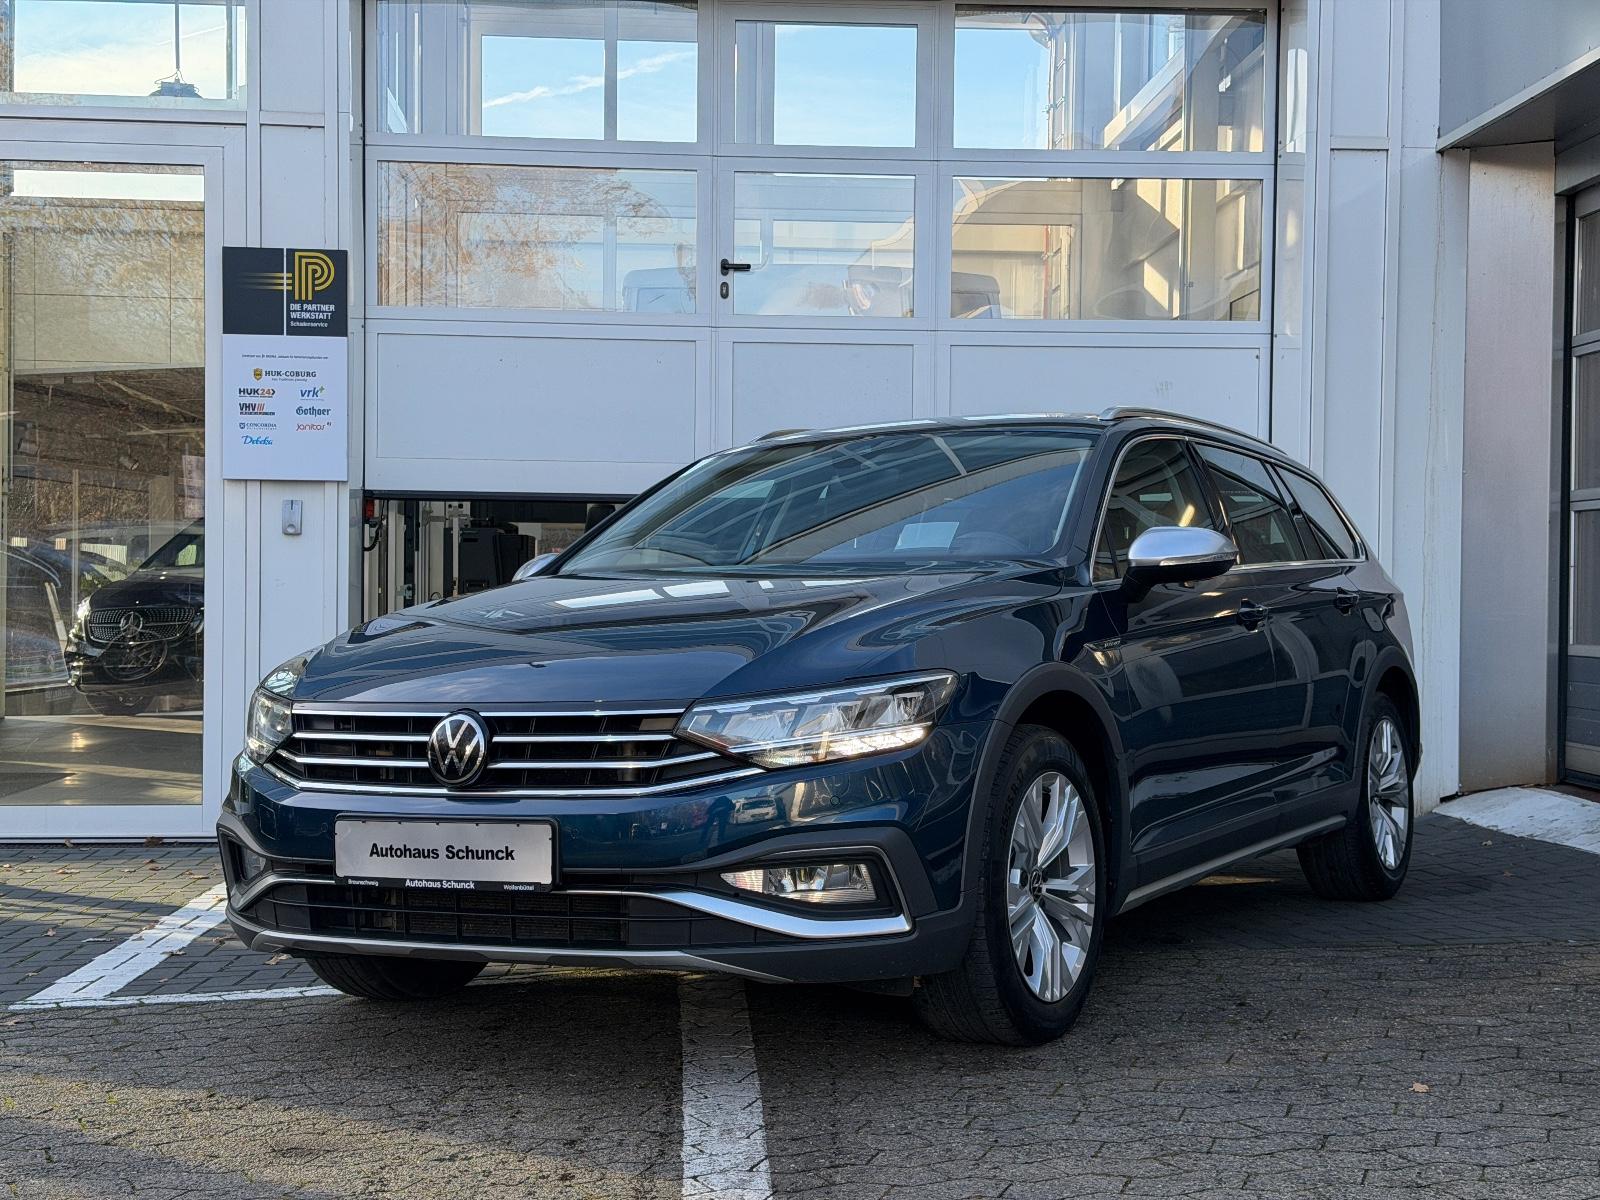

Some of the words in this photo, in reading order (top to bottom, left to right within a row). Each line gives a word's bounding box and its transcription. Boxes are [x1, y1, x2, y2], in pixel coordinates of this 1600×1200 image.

[290, 303, 302, 311] DIE
[303, 303, 335, 312] PARTNER
[290, 311, 332, 320] WERKSTATT
[264, 370, 317, 378] HUK-COBURG
[295, 405, 331, 417] Gothaer
[369, 842, 440, 860] Autohaus
[445, 844, 516, 861] Schunck
[405, 879, 441, 888] Autohaus
[442, 880, 475, 890] Schunck
